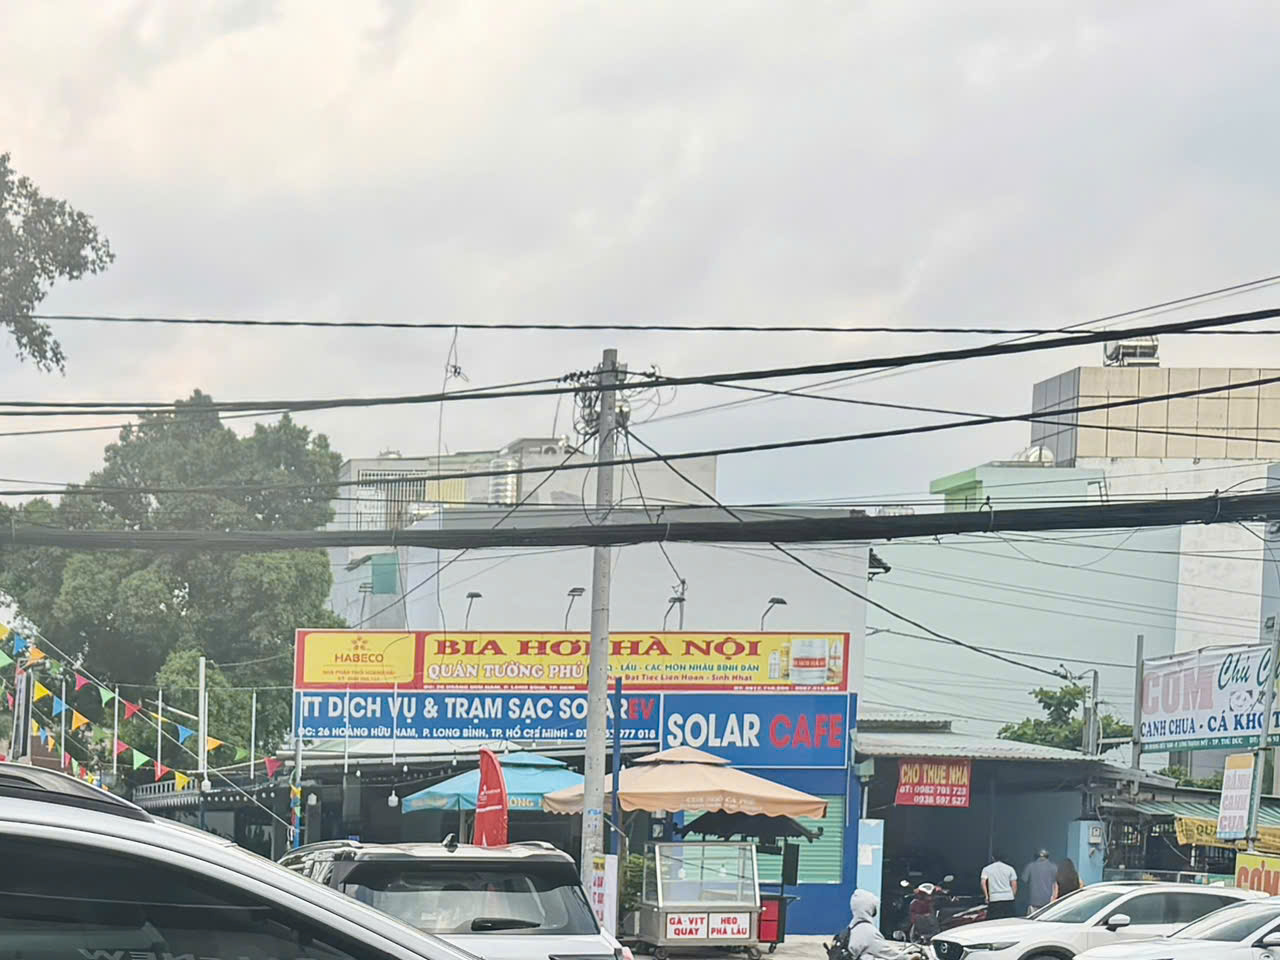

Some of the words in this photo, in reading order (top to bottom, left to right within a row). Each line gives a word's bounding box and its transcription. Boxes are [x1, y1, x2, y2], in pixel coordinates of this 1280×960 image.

[334, 653, 384, 663] HABECO
[434, 639, 507, 656] BIA
[609, 636, 672, 656] HÀ
[681, 636, 762, 660] NỘI
[428, 660, 479, 679] QUÁN
[484, 659, 545, 679] TƯỜNG
[549, 660, 584, 679] PHÚ
[328, 696, 381, 723] DỊCH
[387, 697, 416, 723] VỤ
[423, 697, 438, 718] &
[445, 697, 502, 724] TRẠM
[508, 697, 553, 724] SẠC
[318, 728, 329, 737] 26
[433, 728, 460, 738] LONG
[667, 712, 761, 748] SOLAR
[770, 713, 843, 749] CAFE
[1140, 718, 1166, 737] CANH
[1168, 717, 1195, 735] CHUA
[1207, 710, 1228, 732] CÁ
[901, 764, 920, 784] CHO
[720, 916, 738, 925] HEO
[673, 927, 699, 936] QUAY
